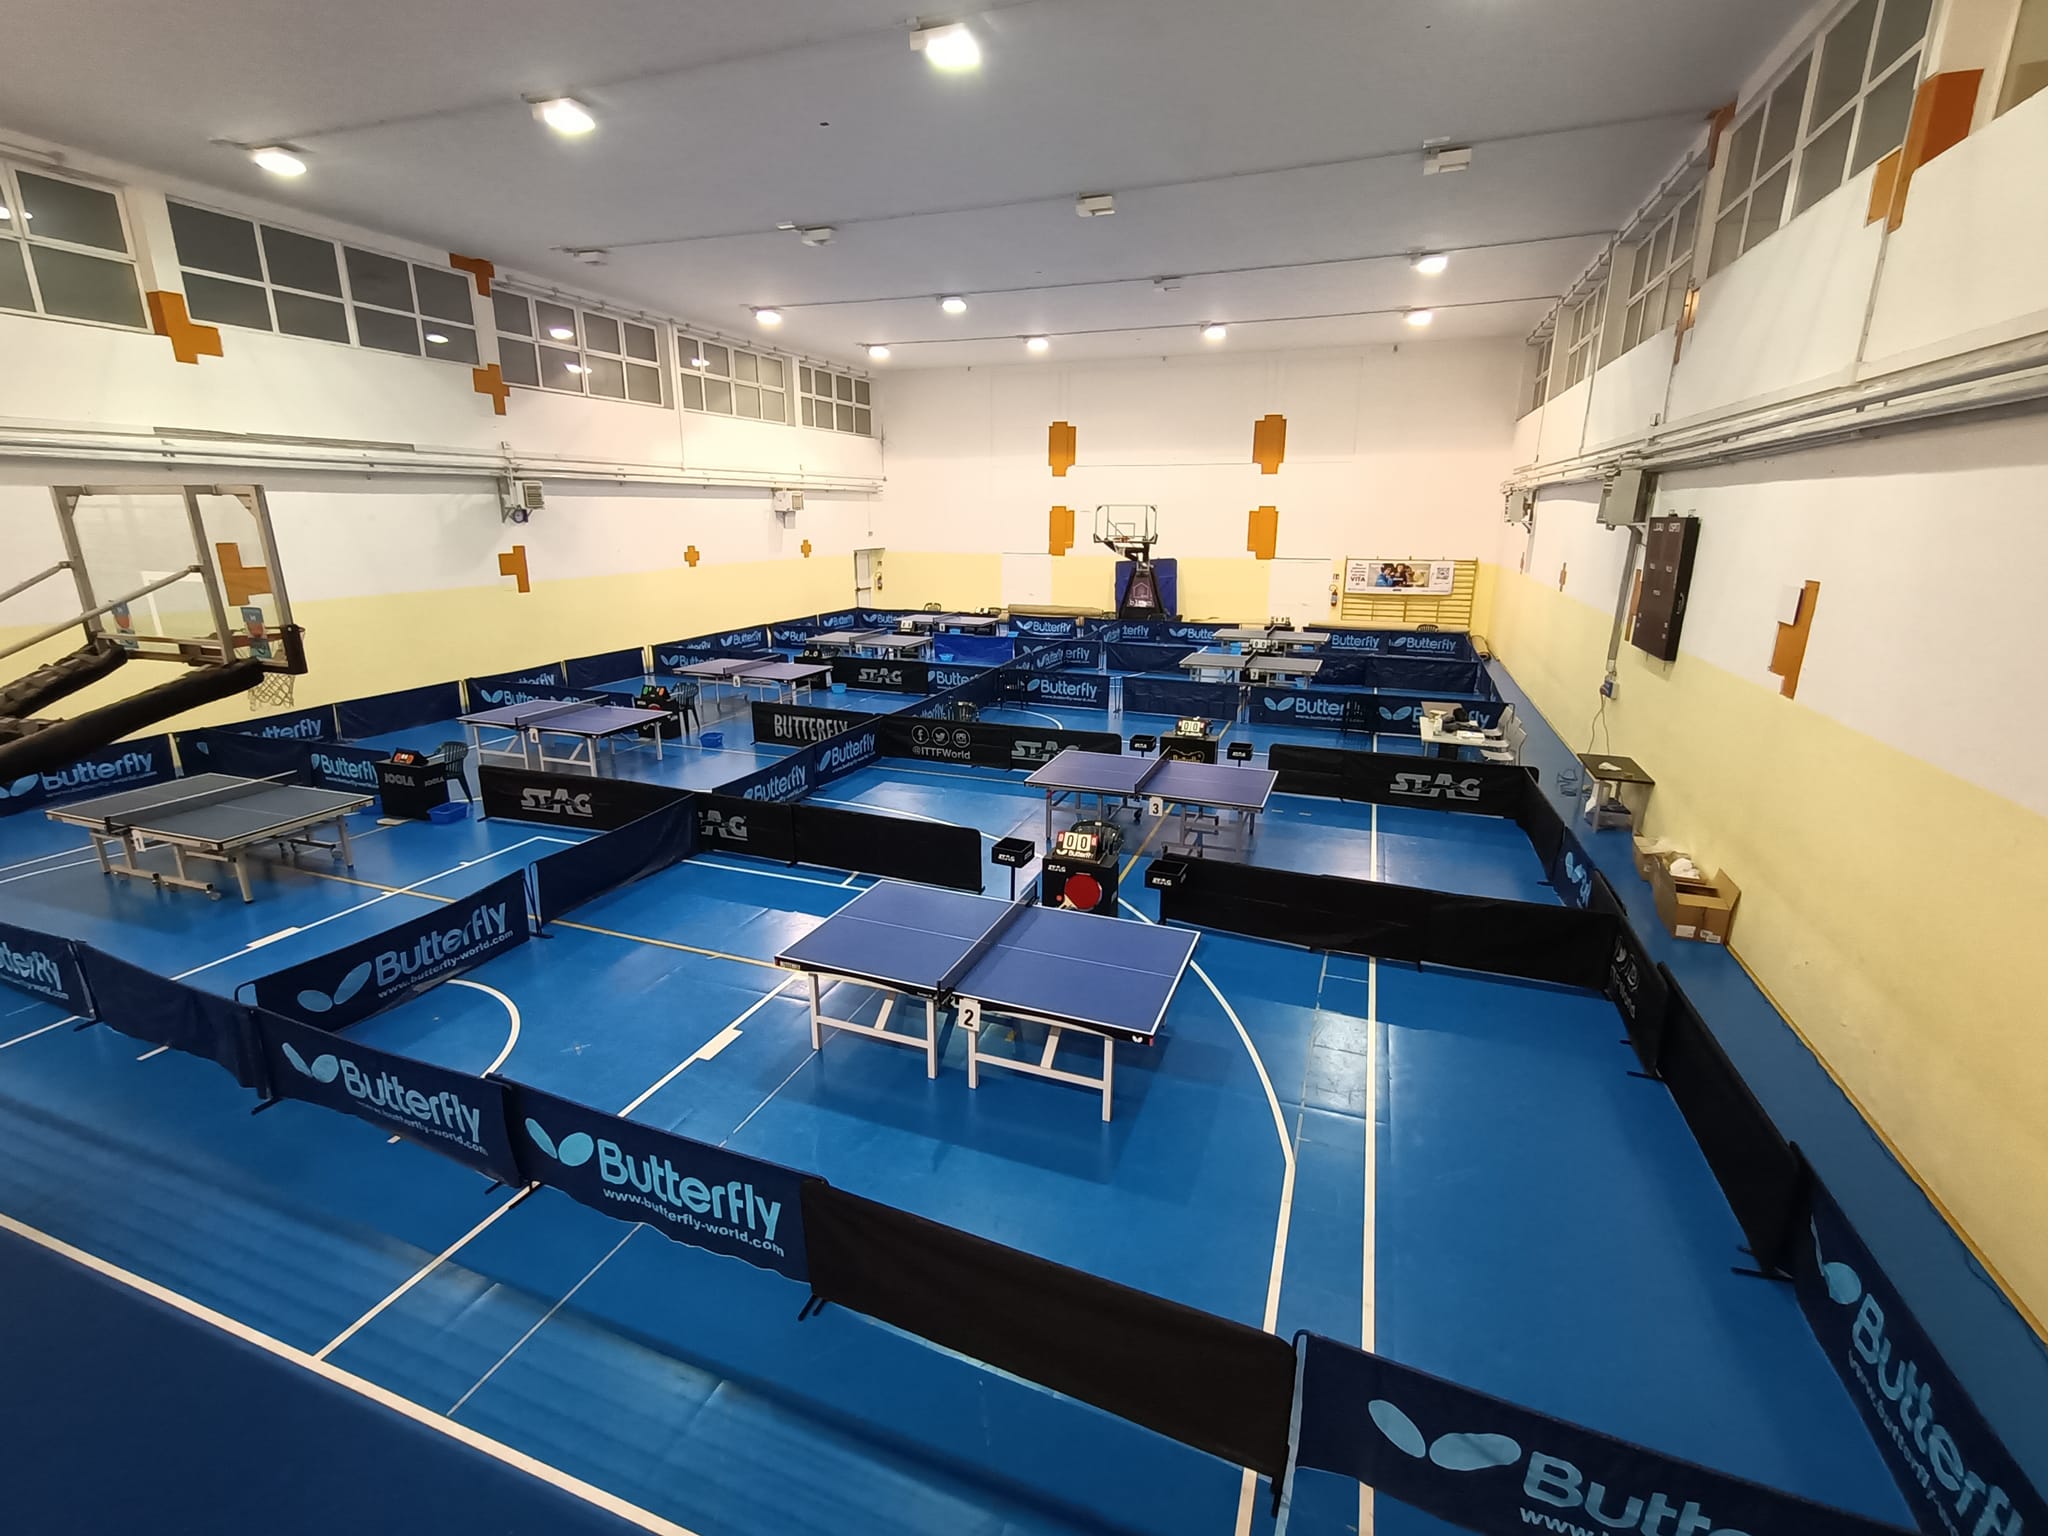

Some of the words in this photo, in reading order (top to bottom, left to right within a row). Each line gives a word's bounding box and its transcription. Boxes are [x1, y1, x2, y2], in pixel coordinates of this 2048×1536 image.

[1032, 621, 1072, 632] Butterfly
[1122, 625, 1150, 636] terfly
[1187, 628, 1214, 639] Butte
[1065, 647, 1090, 660] erfly
[1331, 634, 1380, 649] Butterfly
[1406, 636, 1456, 651] Butterfly
[858, 667, 903, 684] STAG
[1040, 679, 1097, 699] Butterfly
[1295, 698, 1344, 717] Butter
[774, 713, 848, 743] BUTTERFLY
[831, 733, 876, 767] Butterfly
[912, 745, 971, 760] @ITTFWorld
[754, 764, 806, 800] Butterfly
[1389, 772, 1483, 800] STAG
[520, 787, 593, 818] STAG
[1152, 803, 1159, 814] 3
[698, 809, 749, 841] AG
[374, 902, 506, 987] Butterfly
[377, 929, 515, 999] www.butterfly-world.com
[964, 1009, 974, 1027] 2
[340, 1058, 480, 1143] Butterfly
[596, 1138, 782, 1241] Butterfly
[603, 1187, 786, 1258] www.butterfly-world.com
[1523, 1451, 1752, 1536] Butt
